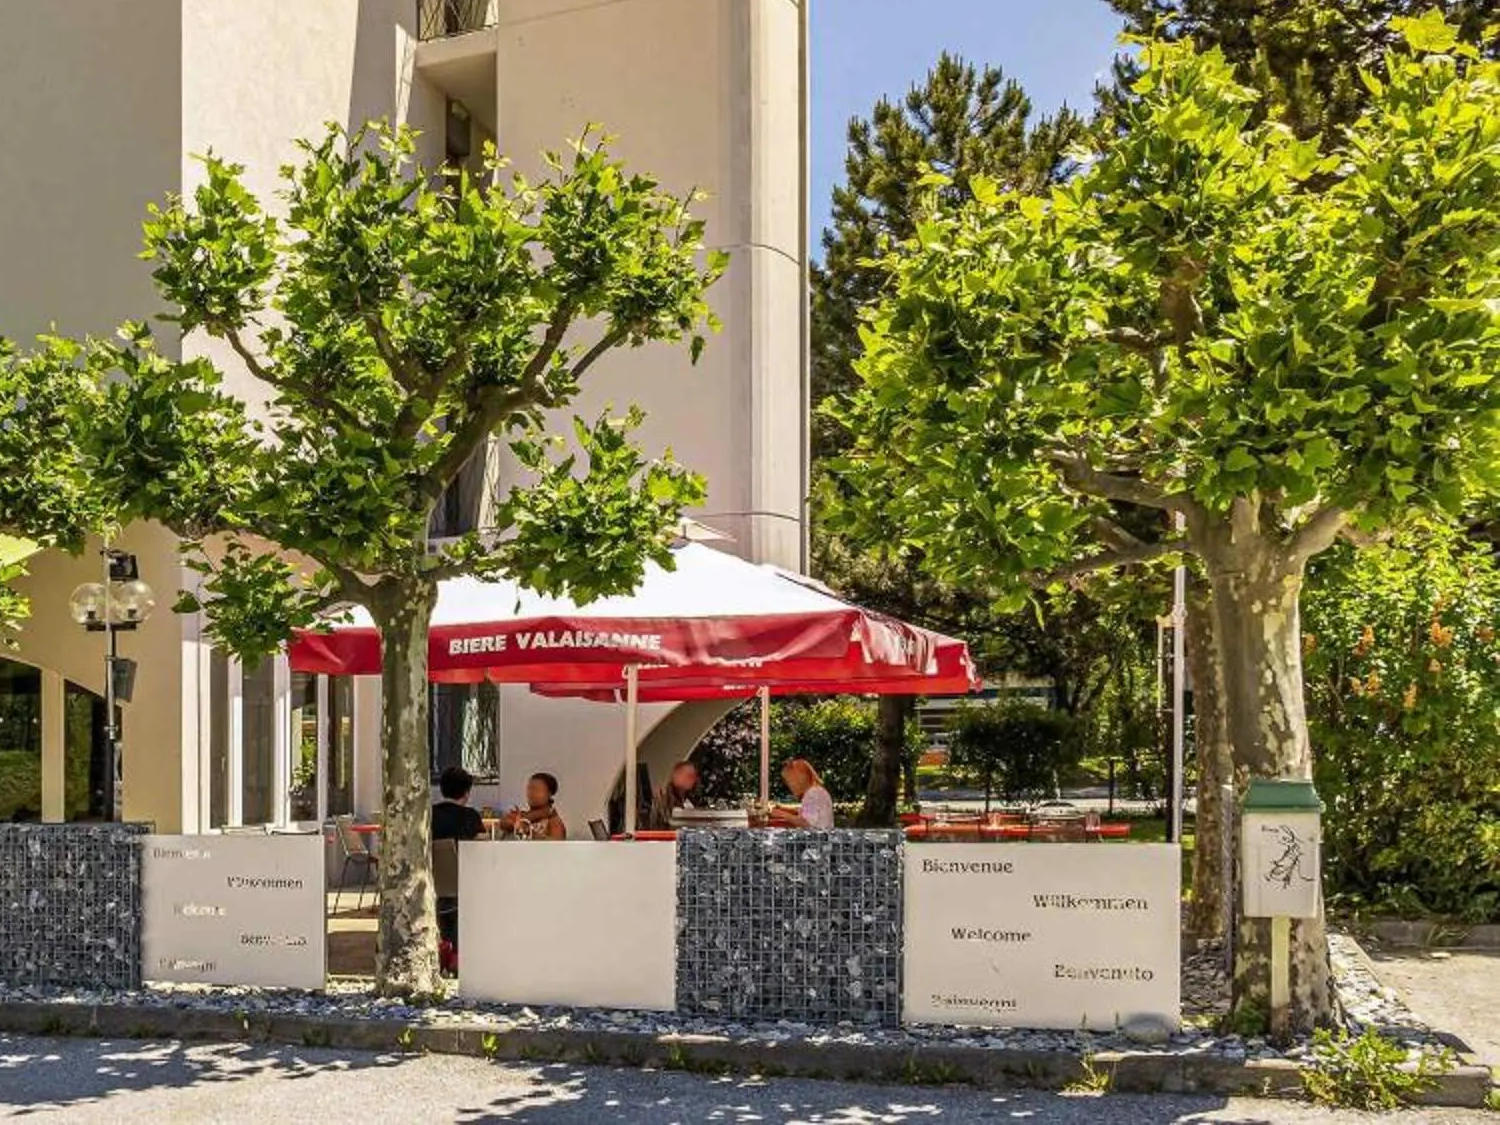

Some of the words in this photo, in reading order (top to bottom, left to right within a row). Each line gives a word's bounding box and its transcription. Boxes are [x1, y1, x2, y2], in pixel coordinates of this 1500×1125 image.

[449, 634, 507, 655] BIERE
[515, 630, 662, 651] VALAISANNE
[922, 858, 1013, 875] Bienvenue
[951, 927, 1032, 943] Welcome
